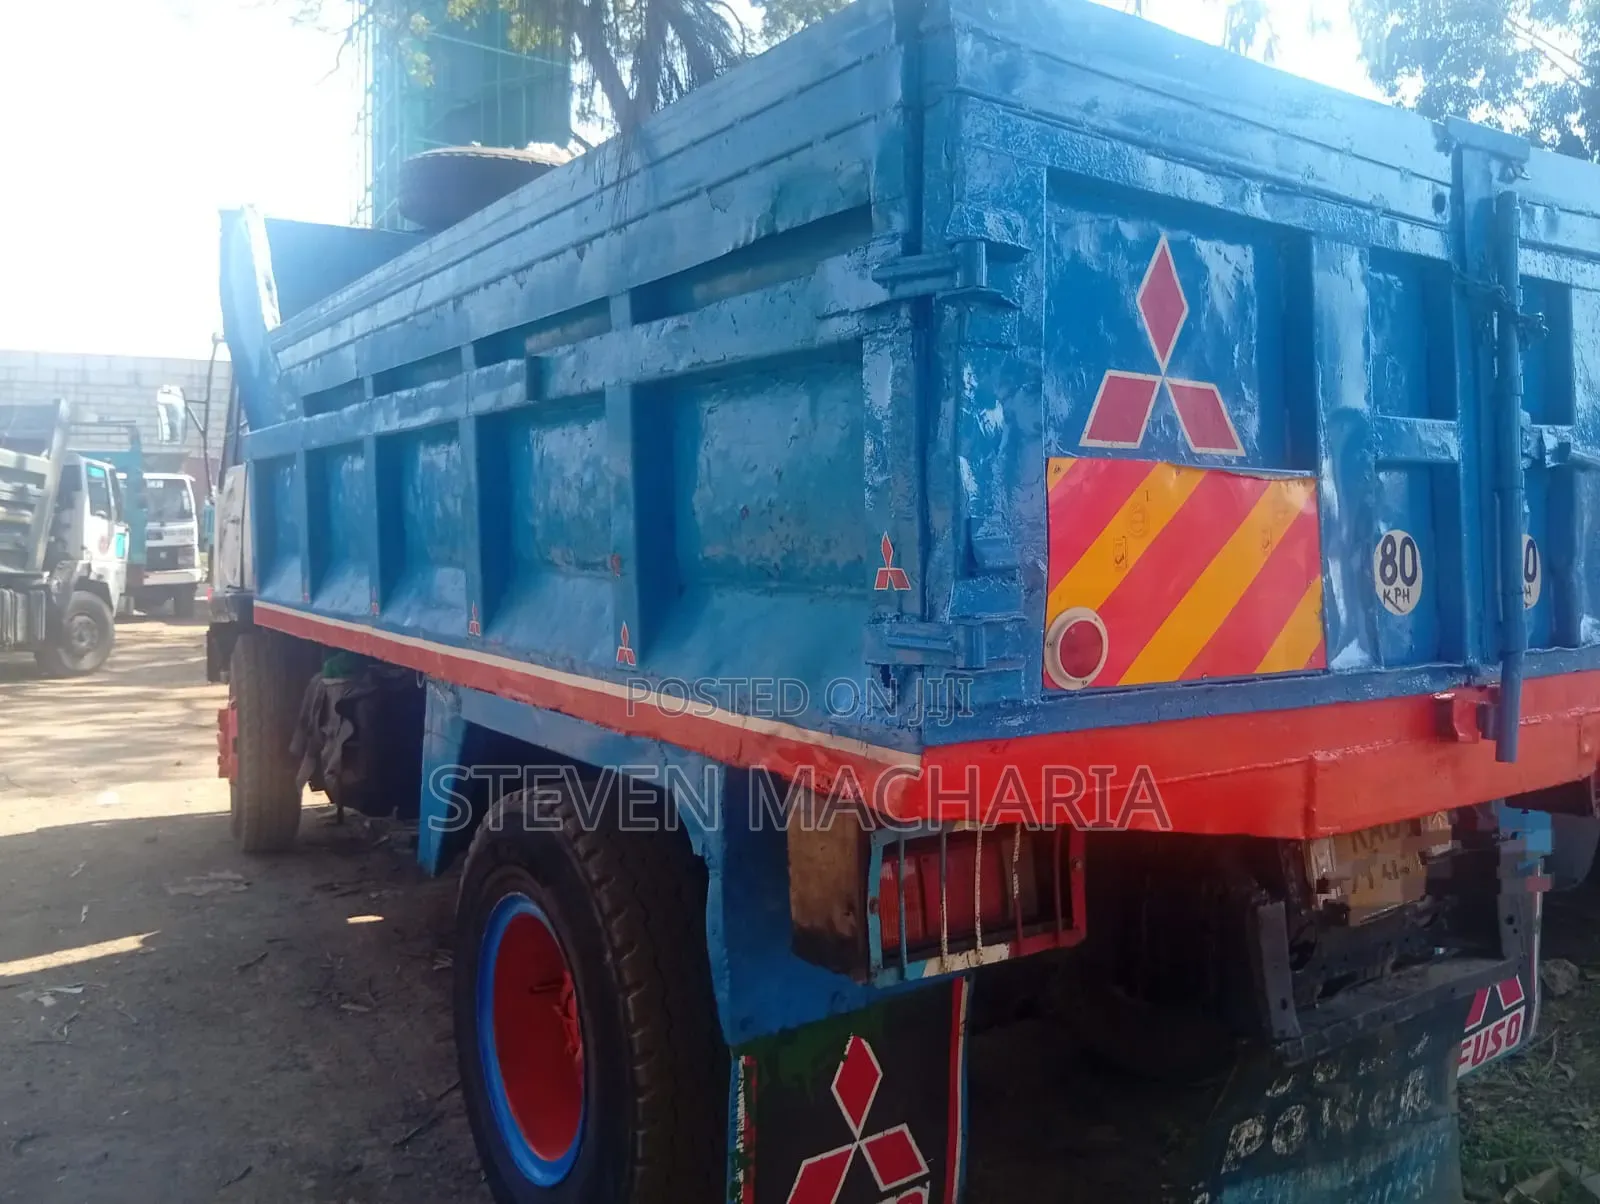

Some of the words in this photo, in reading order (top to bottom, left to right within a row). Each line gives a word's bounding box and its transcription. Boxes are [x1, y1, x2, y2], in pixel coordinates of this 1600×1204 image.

[1379, 534, 1418, 587] 80
[1523, 539, 1538, 584] 0
[1382, 587, 1411, 613] KPH
